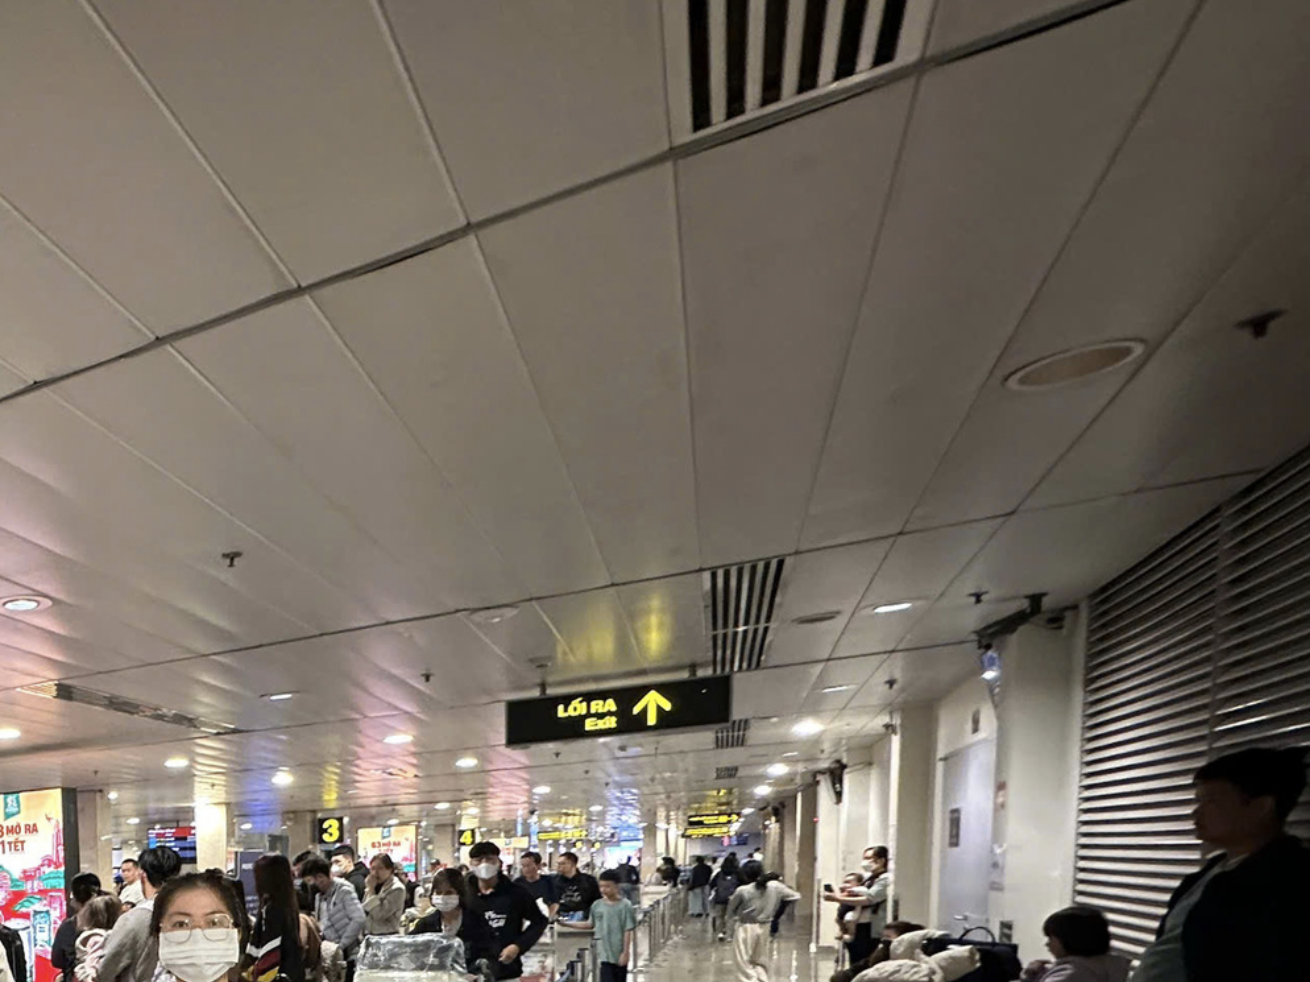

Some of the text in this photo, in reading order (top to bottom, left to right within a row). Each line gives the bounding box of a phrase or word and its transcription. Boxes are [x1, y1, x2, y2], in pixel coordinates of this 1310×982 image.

[590, 698, 617, 714] RA
[585, 716, 617, 731] Exit
[24, 823, 39, 835] RA
[322, 819, 339, 843] 3
[459, 830, 473, 846] 4
[0, 839, 6, 854] 1
